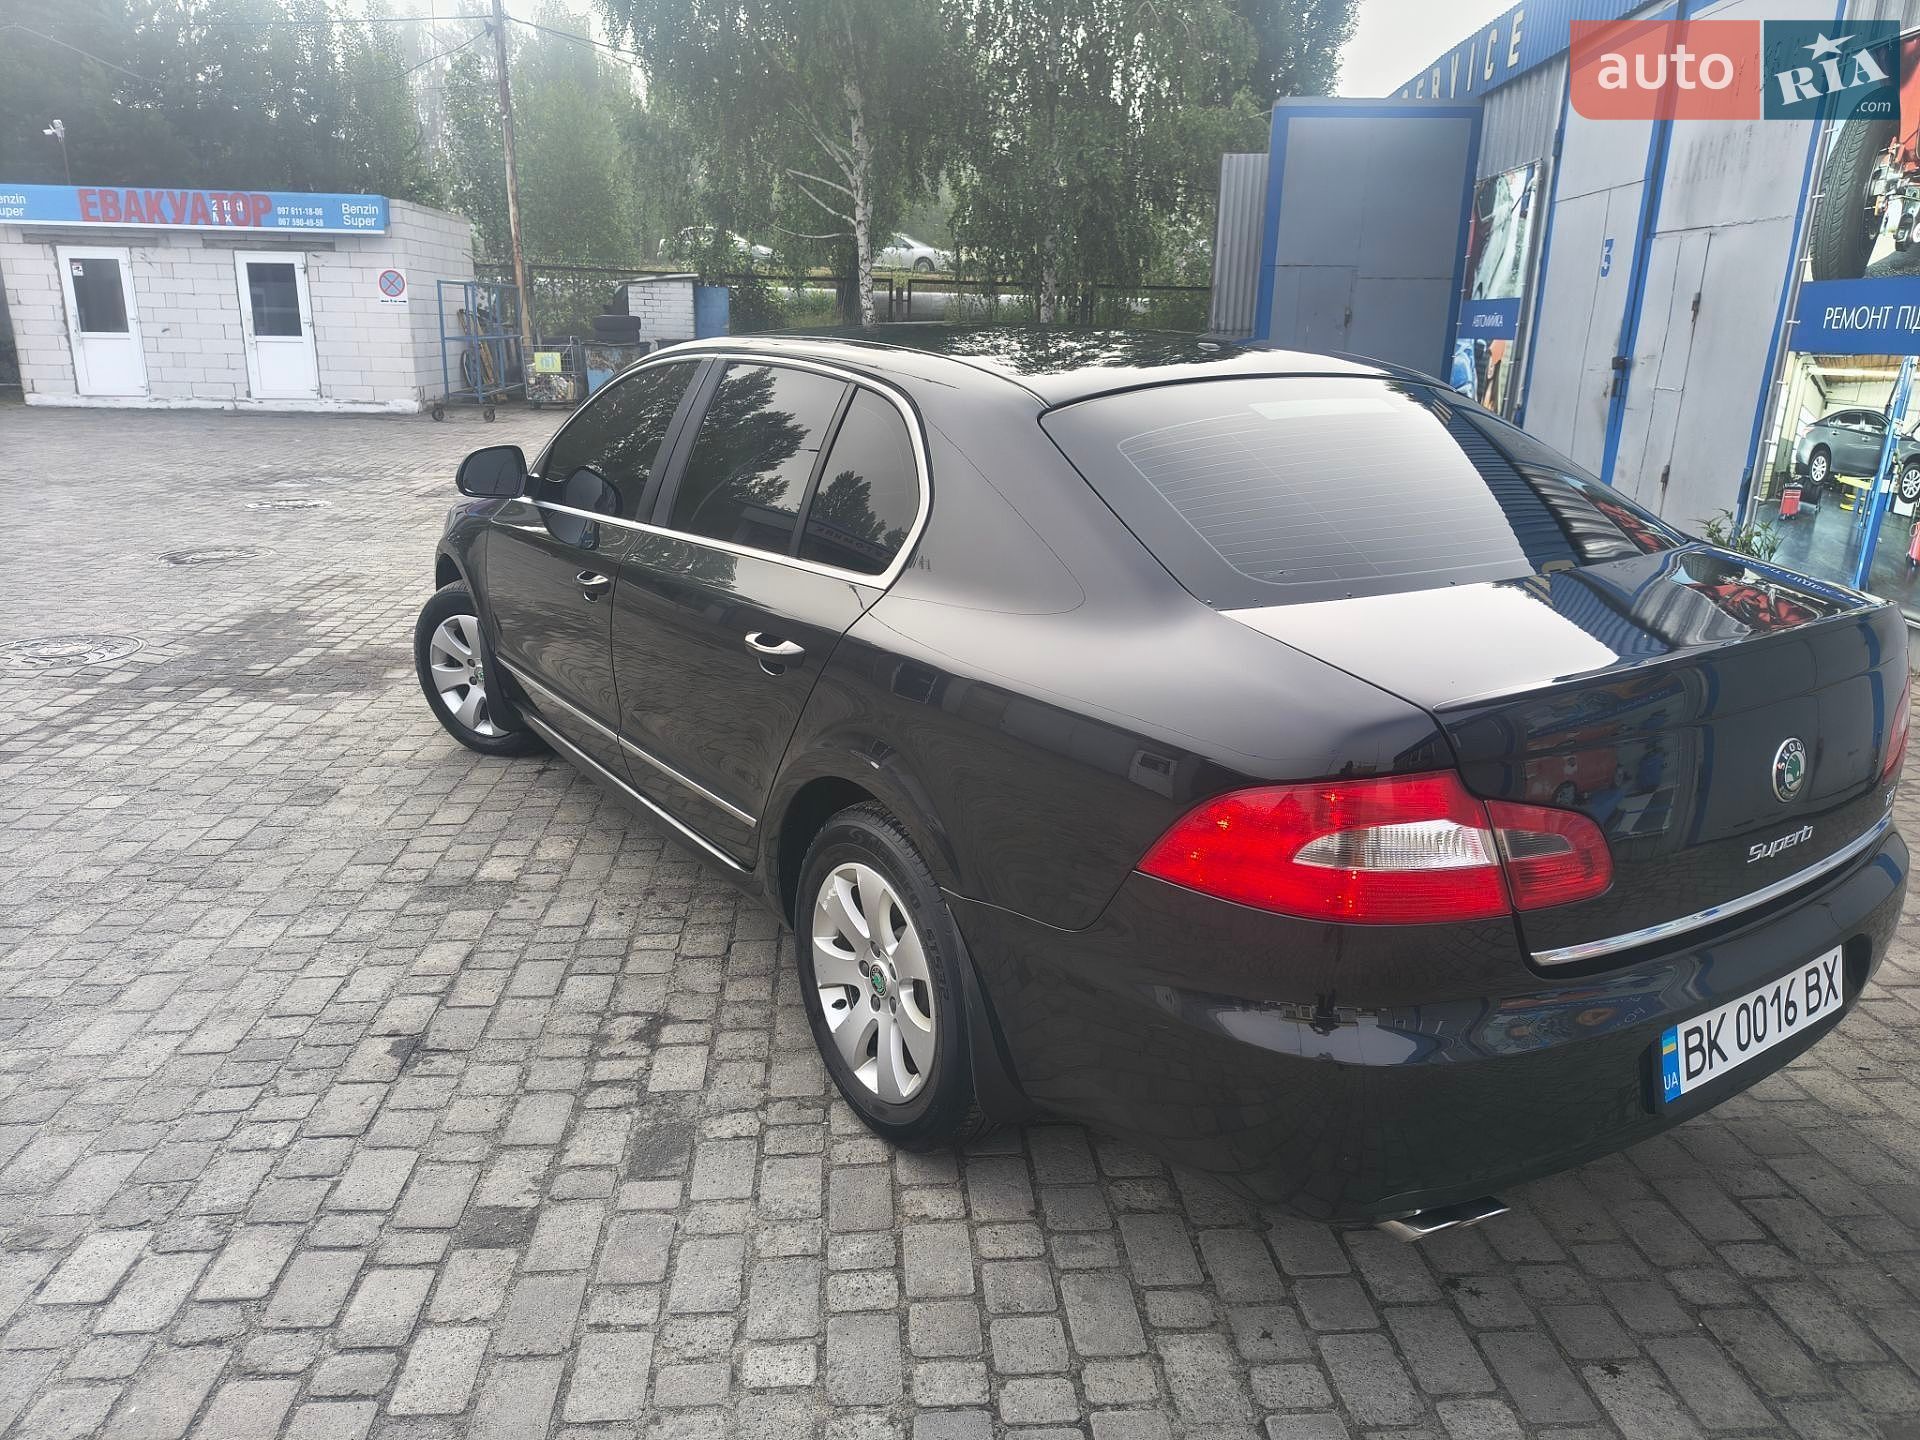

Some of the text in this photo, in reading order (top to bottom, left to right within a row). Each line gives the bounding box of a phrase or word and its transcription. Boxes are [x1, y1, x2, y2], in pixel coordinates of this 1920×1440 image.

[78, 188, 272, 227] ЕВАКУАТОР
[341, 202, 379, 215] Benzin
[343, 214, 377, 228] Super
[1822, 305, 1894, 330] РЕМОНТ
[1746, 825, 1814, 864] Superb
[1683, 954, 1839, 1081] BK 0016 BX
[1663, 1071, 1680, 1090] UA
